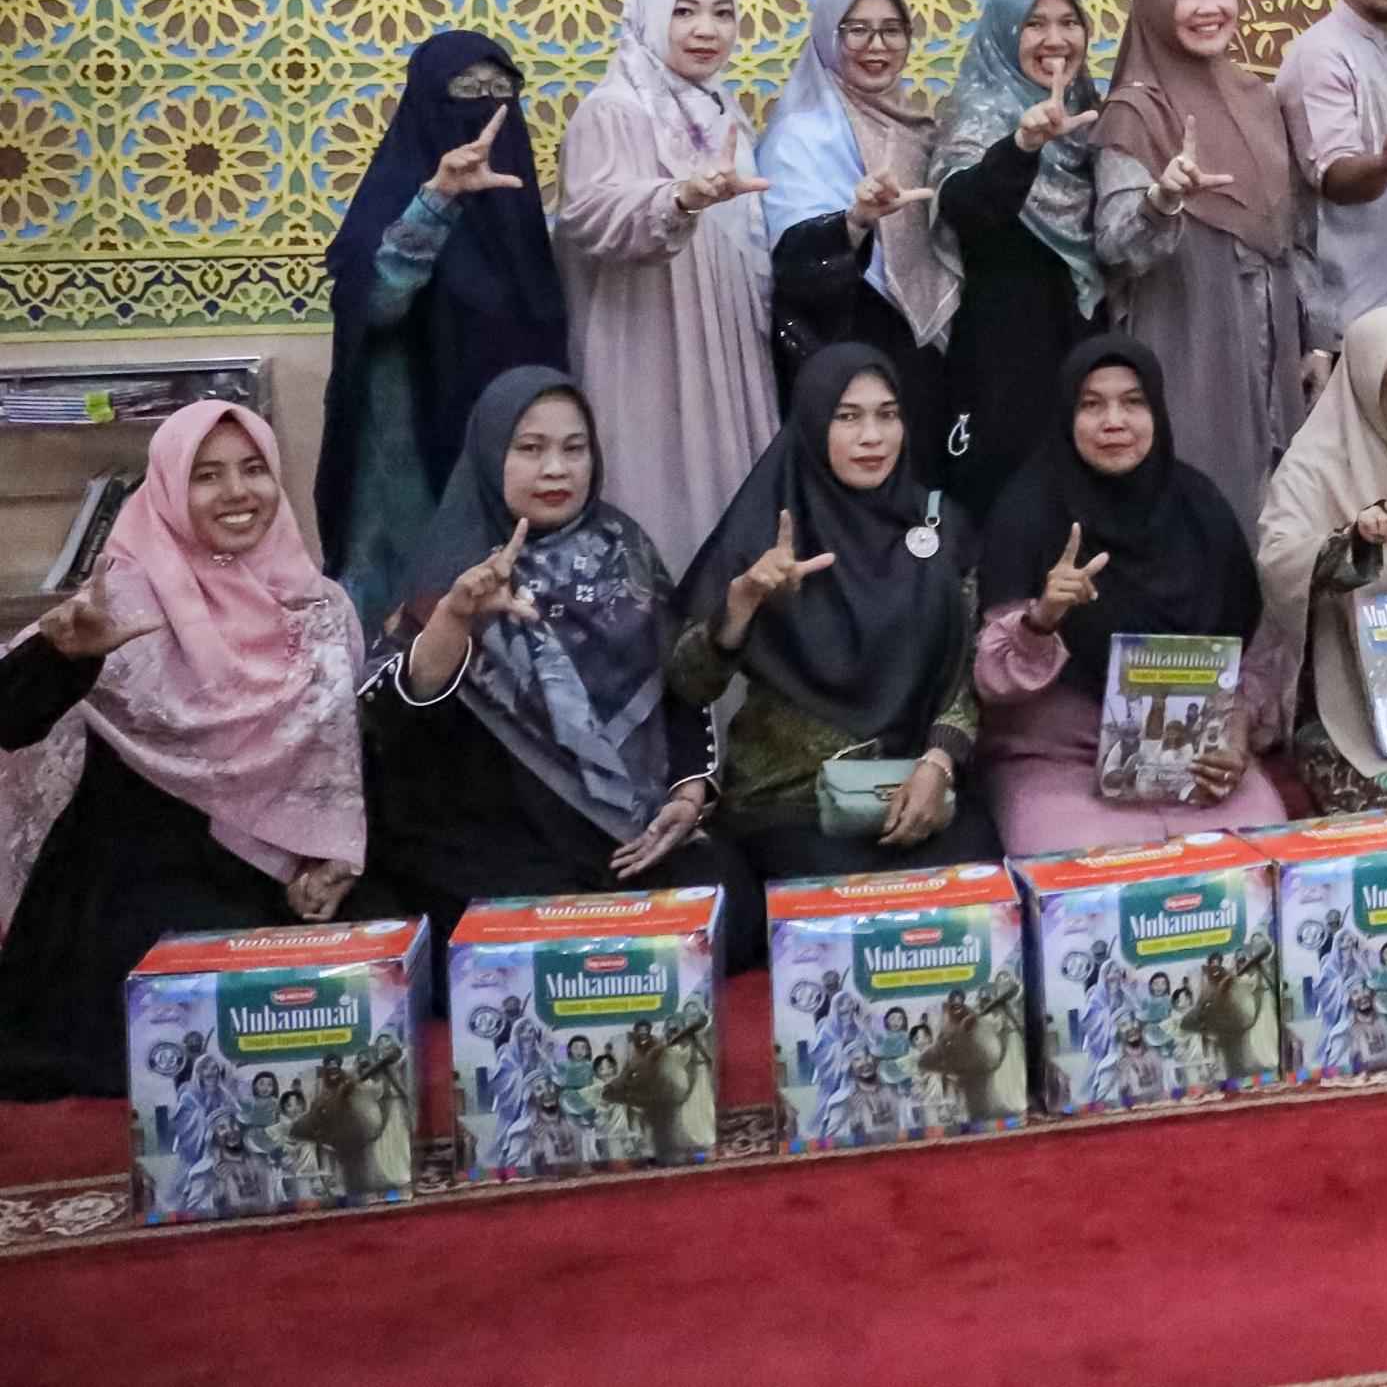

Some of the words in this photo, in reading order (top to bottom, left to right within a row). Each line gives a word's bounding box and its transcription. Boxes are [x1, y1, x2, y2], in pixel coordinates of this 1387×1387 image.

[1130, 900, 1238, 938] Muhammad
[865, 939, 981, 971] Muhammad
[546, 965, 668, 998] Muhammad
[230, 997, 359, 1033] Muhammad
